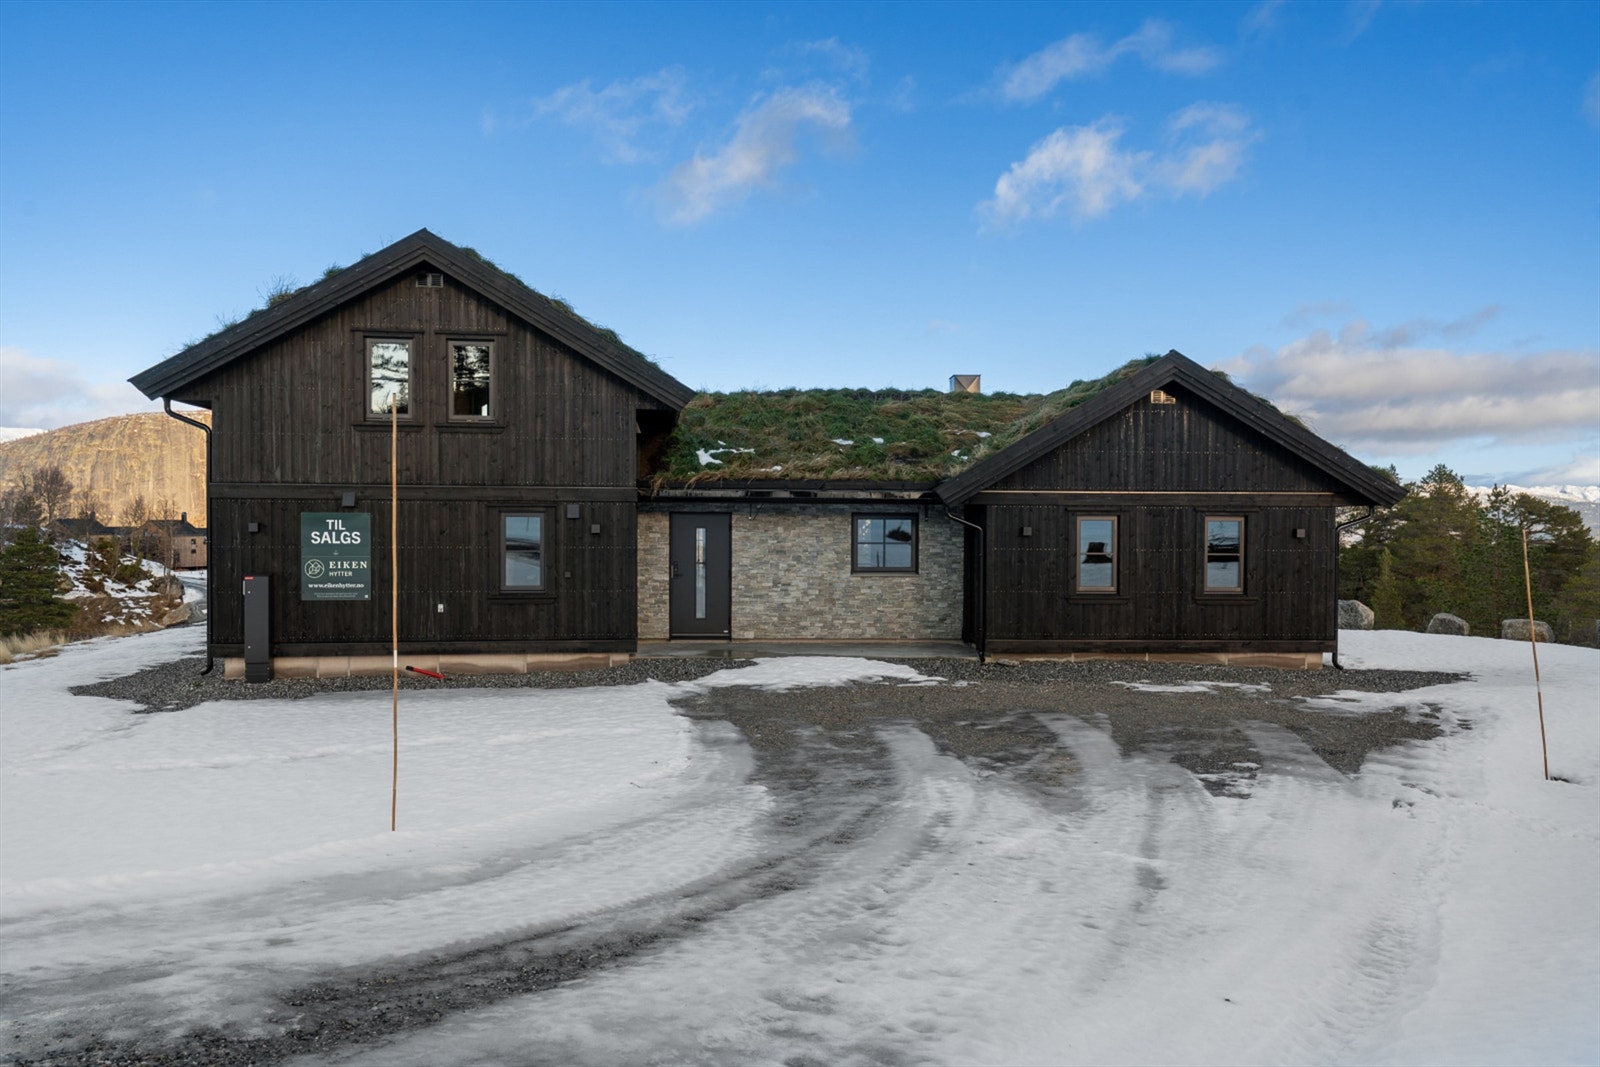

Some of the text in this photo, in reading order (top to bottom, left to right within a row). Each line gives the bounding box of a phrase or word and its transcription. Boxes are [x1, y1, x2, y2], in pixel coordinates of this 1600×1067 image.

[326, 519, 346, 530] TIL
[311, 531, 361, 544] SALGS
[329, 561, 367, 569] EIKEN
